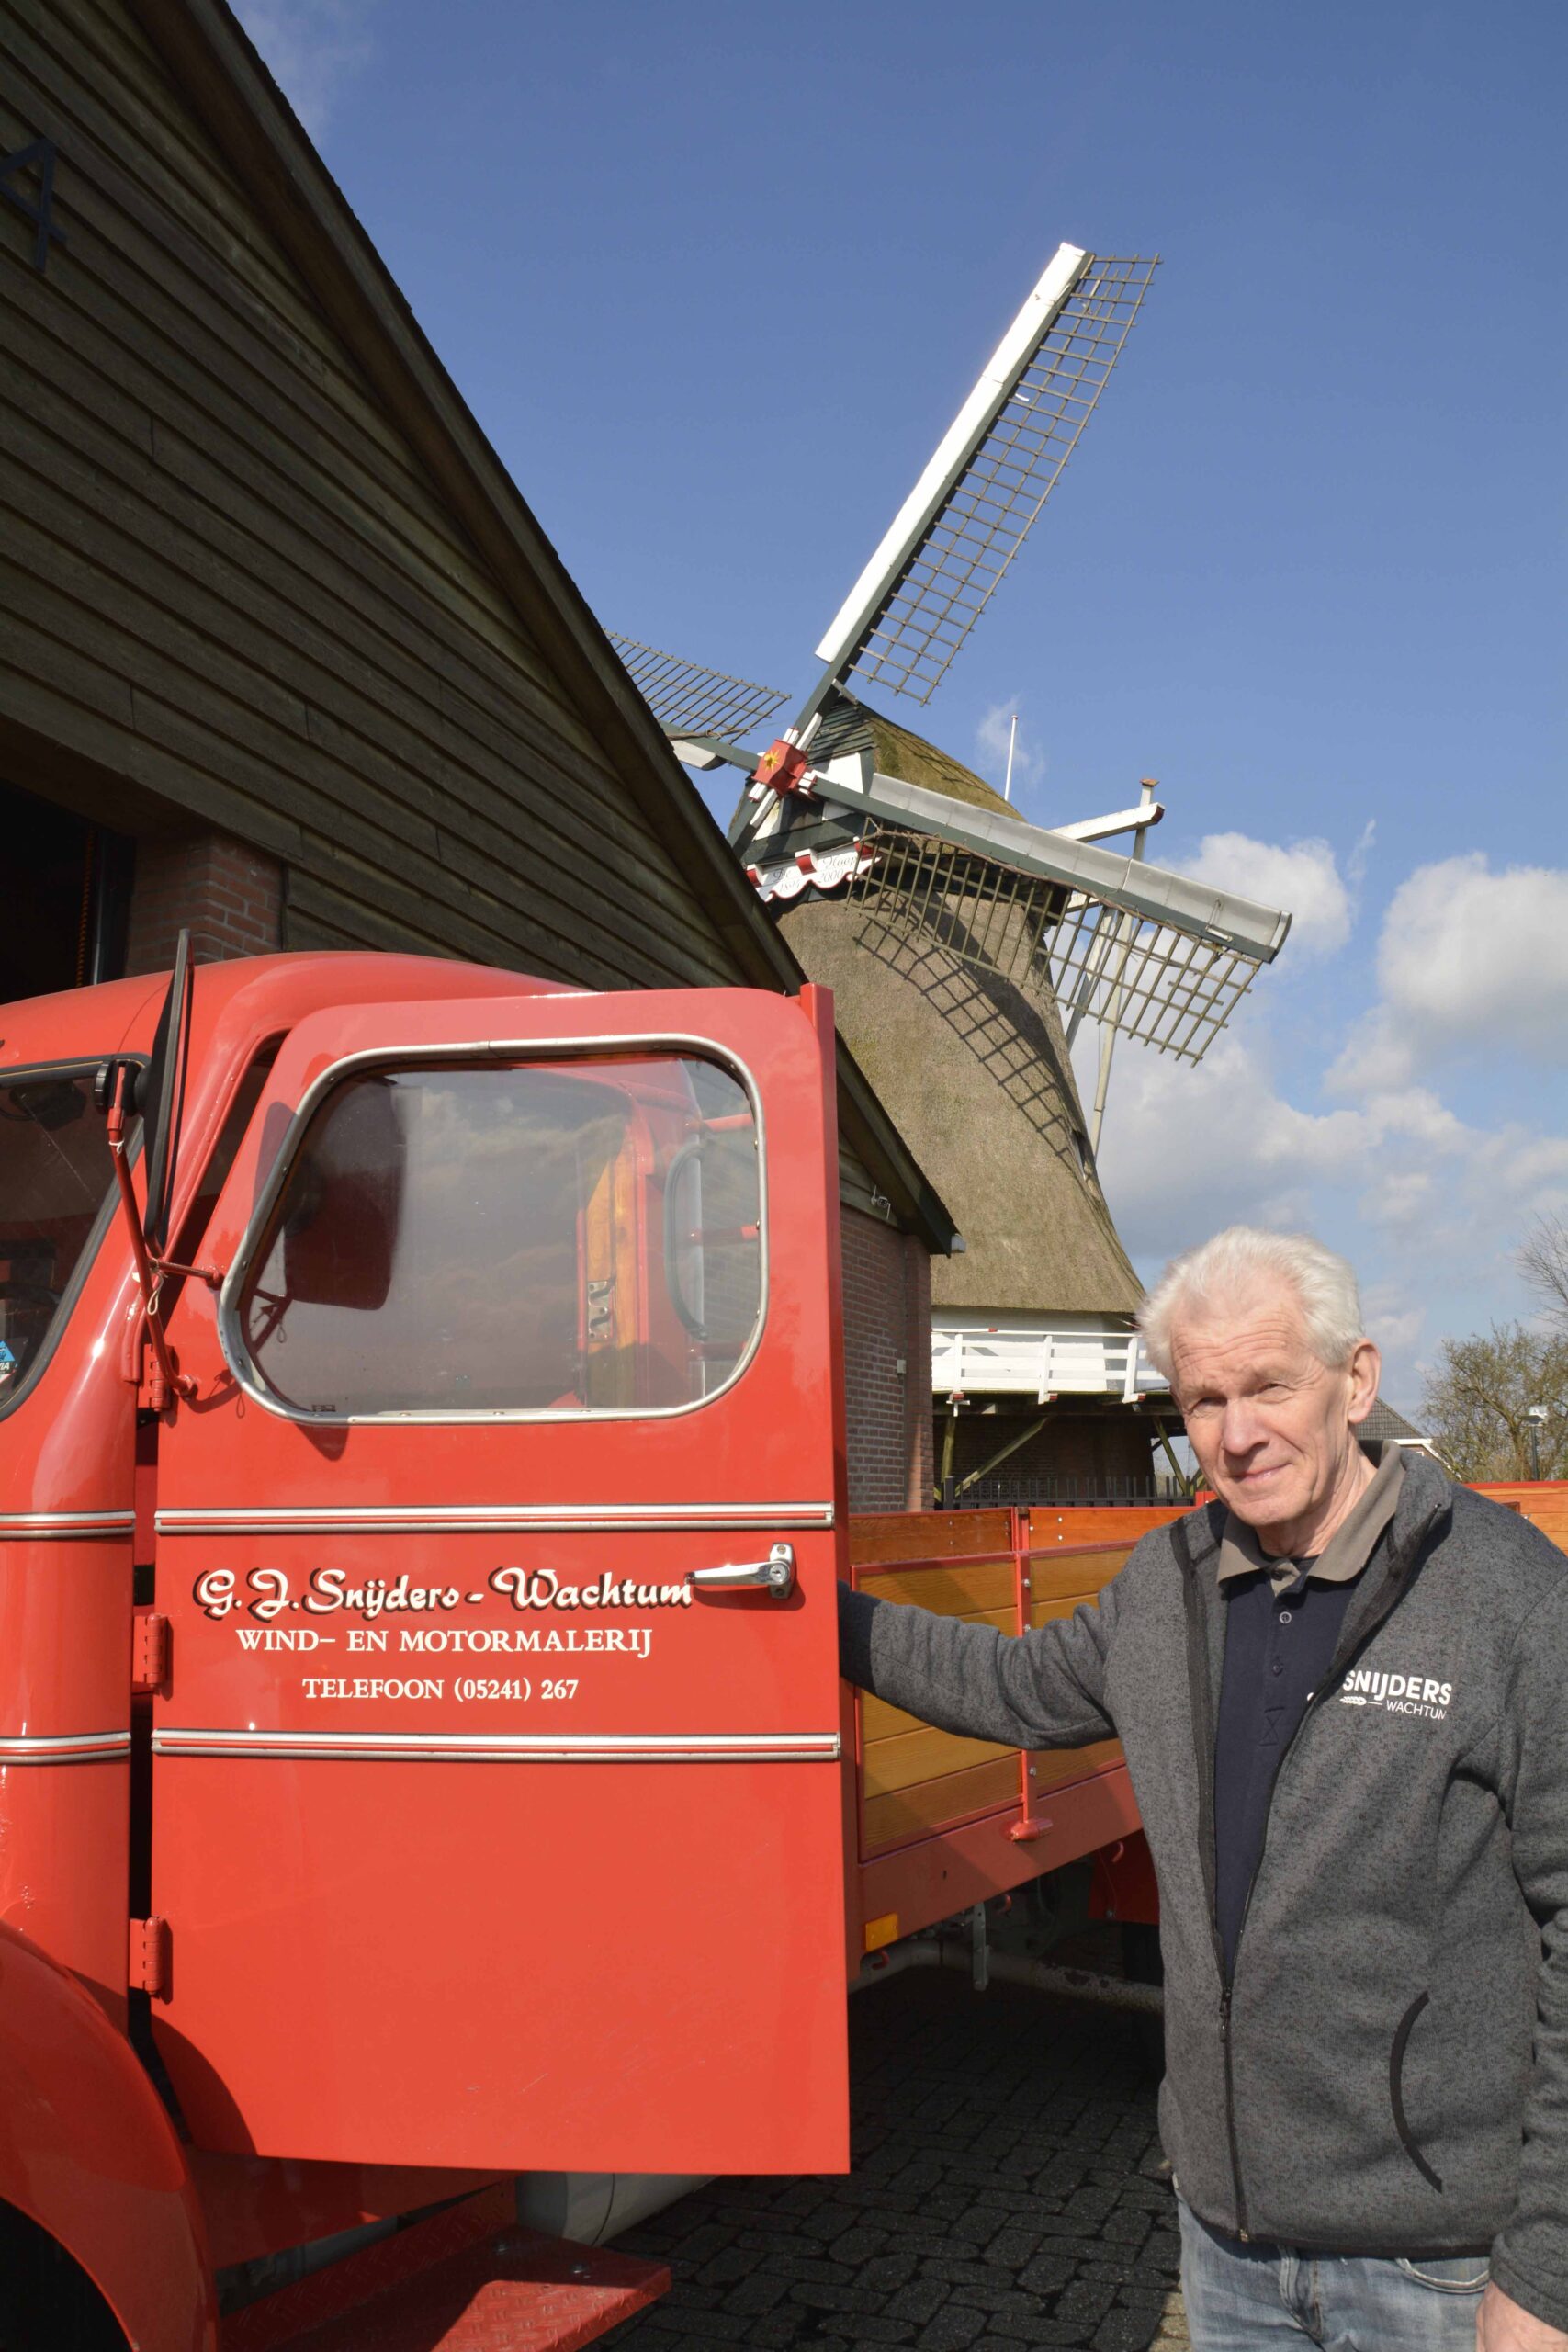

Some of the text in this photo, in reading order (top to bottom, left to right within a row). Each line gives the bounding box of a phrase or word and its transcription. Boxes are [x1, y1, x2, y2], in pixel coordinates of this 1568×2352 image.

[488, 1566, 693, 1611] Wachtum
[235, 1628, 653, 1659] WIND- EN MOTORMALERIJ
[301, 1677, 580, 1702] TELEFOON (05241) 267
[1342, 1670, 1453, 1706] SNIJDERS
